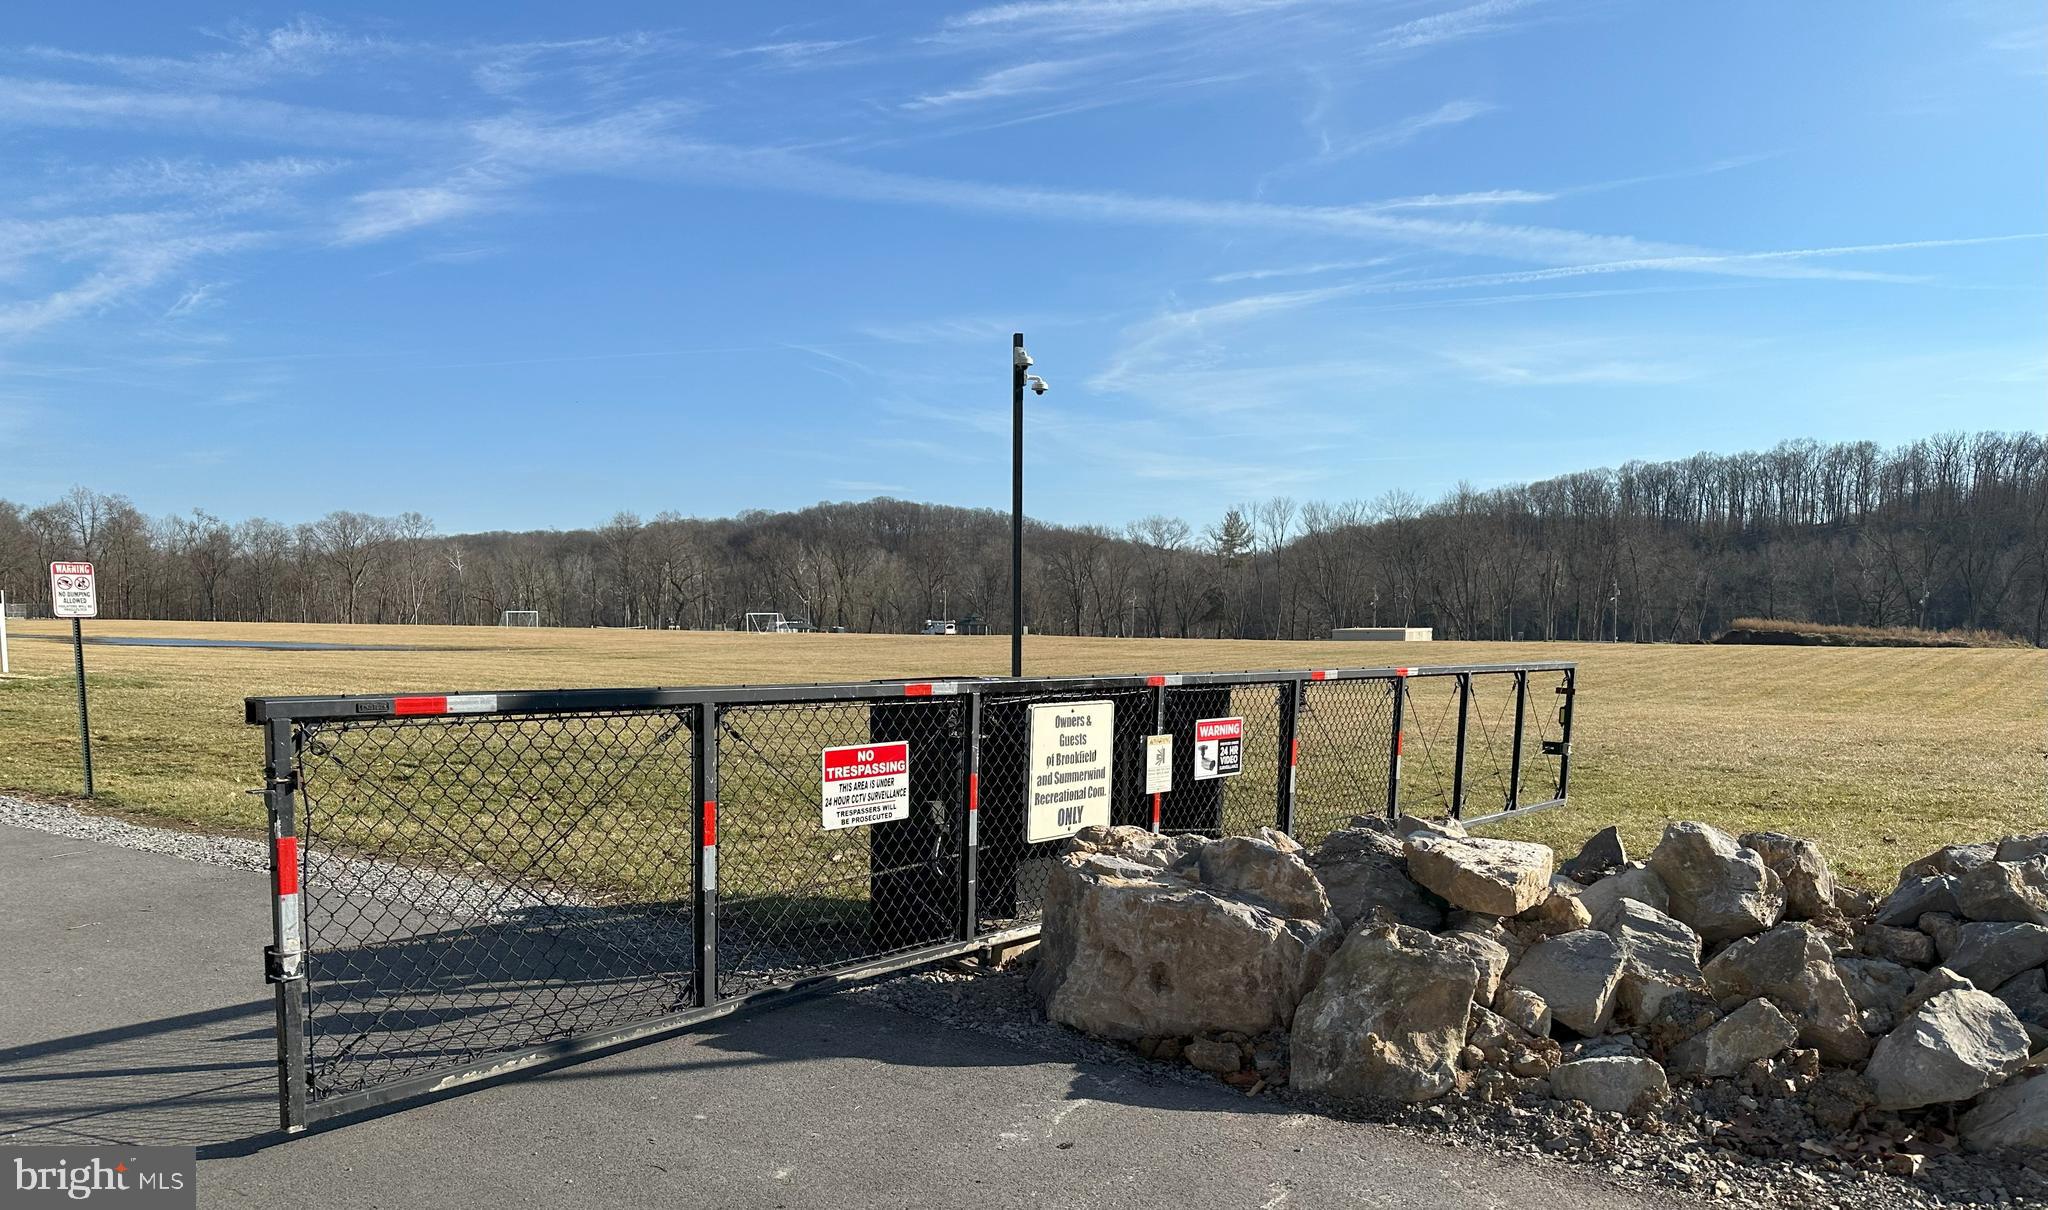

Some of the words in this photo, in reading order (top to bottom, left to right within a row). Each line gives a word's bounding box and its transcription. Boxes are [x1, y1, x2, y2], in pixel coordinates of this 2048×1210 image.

[55, 564, 90, 574] WARNING
[1055, 715, 1085, 728] Owners
[1086, 715, 1092, 726] &
[1199, 723, 1240, 737] WARNING
[1059, 733, 1087, 747] Guests
[857, 749, 875, 762] NO
[1219, 746, 1229, 756] 24
[1229, 745, 1239, 755] HR
[1046, 753, 1055, 767] of
[1056, 749, 1097, 766] Brookfield
[1219, 754, 1238, 765] VIDEO
[826, 760, 906, 779] TRESPASSING
[1036, 772, 1053, 787] and
[1054, 766, 1106, 785] Summerwind
[839, 782, 852, 793] THIS
[853, 780, 869, 791] AREA
[869, 779, 875, 789] IS
[876, 777, 895, 788] UNDER
[825, 797, 832, 807] 24
[833, 795, 850, 806] HOUR
[851, 793, 867, 804] CCTV
[867, 787, 907, 801] SURVEILLANCE
[1034, 786, 1087, 806] Recreational
[1087, 785, 1107, 799] Com.
[836, 805, 881, 818] TRESPASSERS
[882, 803, 897, 811] WILL
[1057, 805, 1084, 827] ONLY
[841, 818, 850, 826] BE
[851, 812, 893, 824] PROSECUTED
